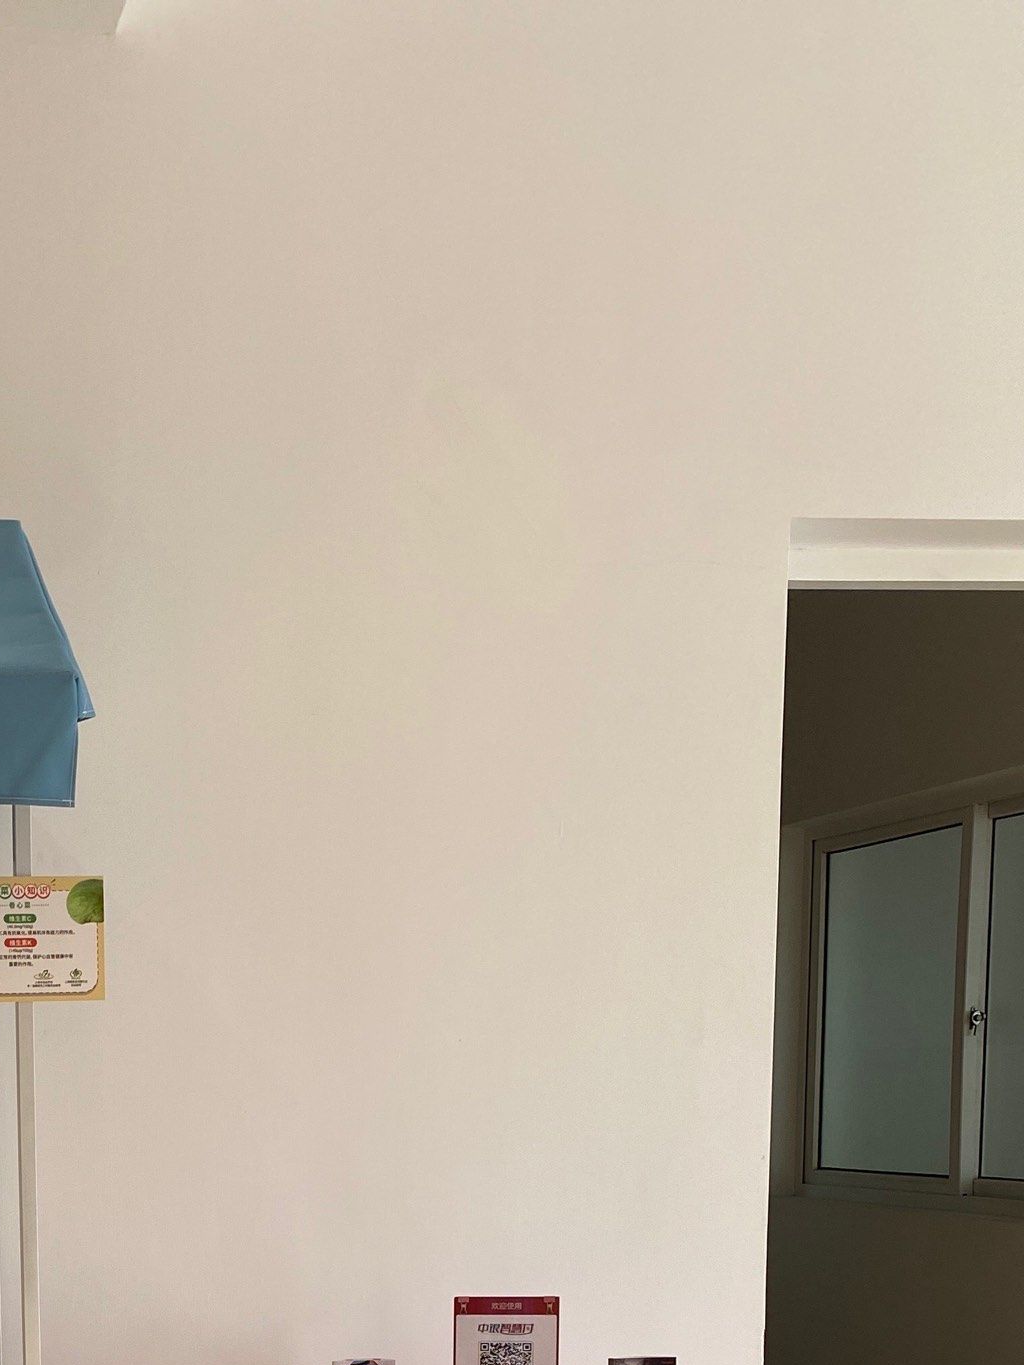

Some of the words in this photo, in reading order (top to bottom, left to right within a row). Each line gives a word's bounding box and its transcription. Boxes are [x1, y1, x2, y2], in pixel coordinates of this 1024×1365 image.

[491, 1302, 522, 1310] 欢迎使用
[477, 1323, 534, 1335] 中银智慧付
